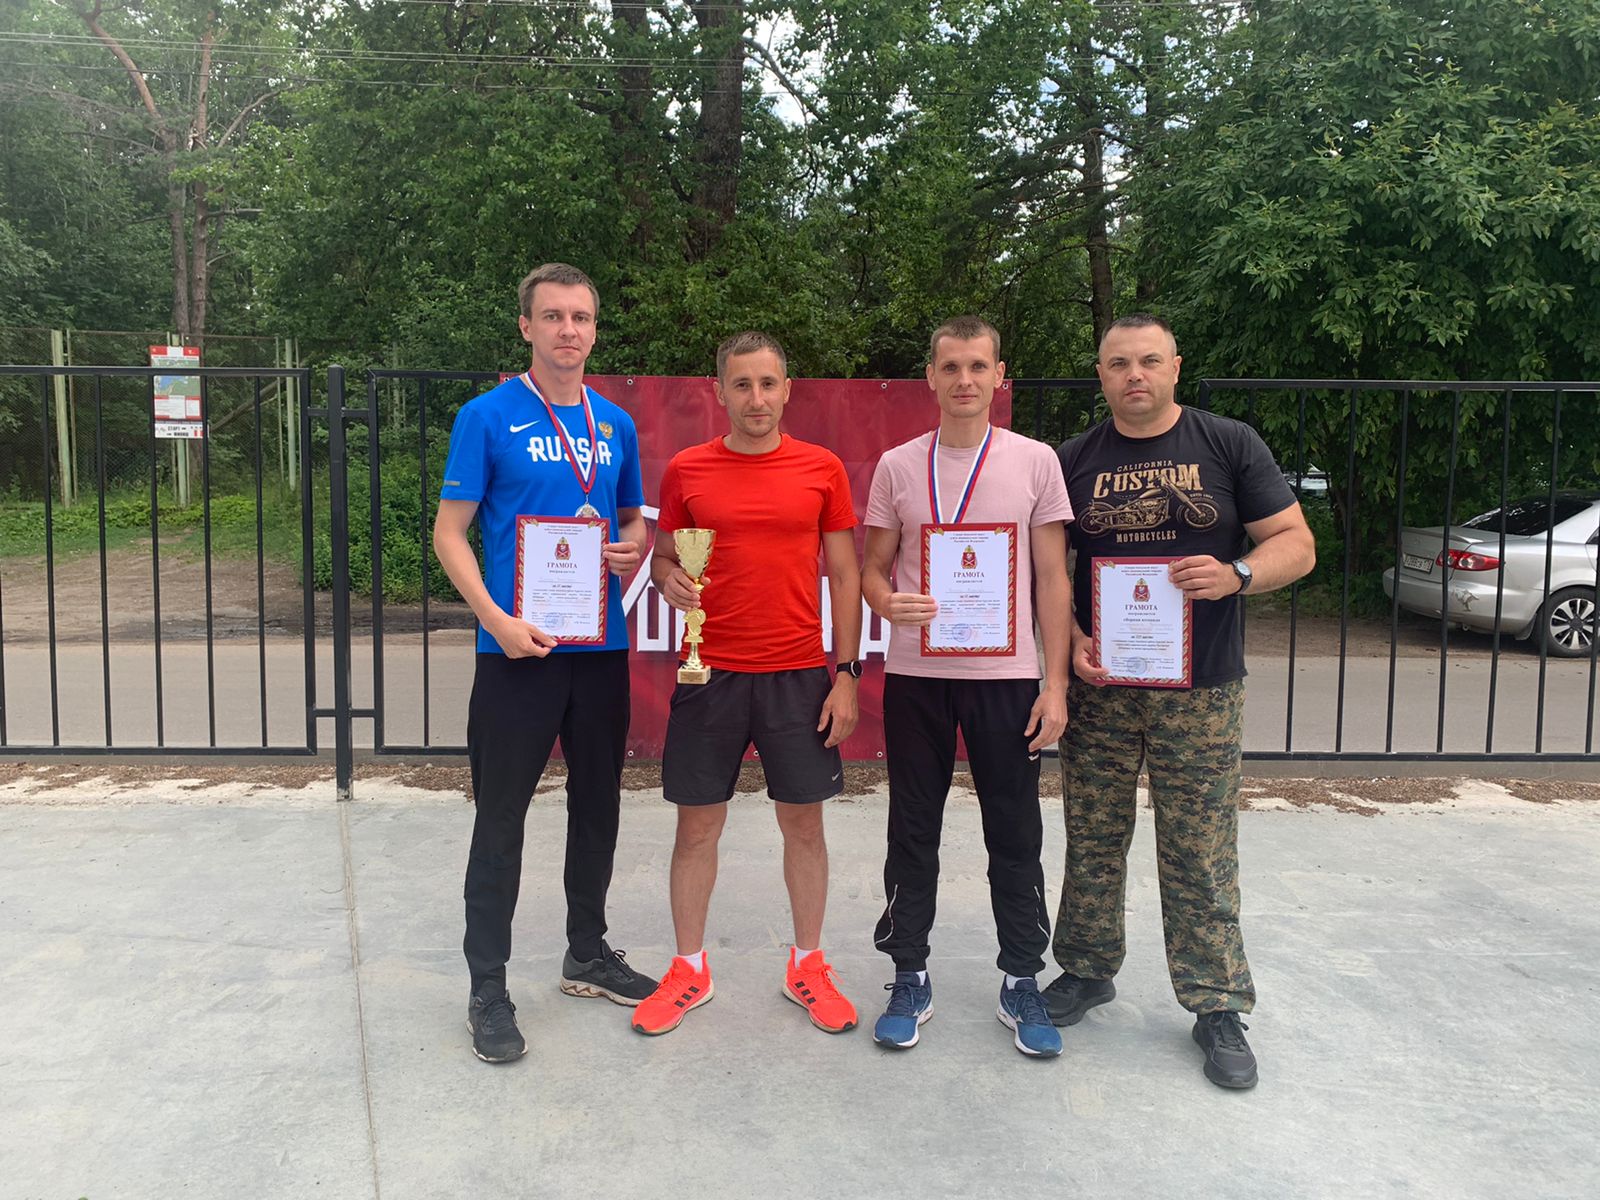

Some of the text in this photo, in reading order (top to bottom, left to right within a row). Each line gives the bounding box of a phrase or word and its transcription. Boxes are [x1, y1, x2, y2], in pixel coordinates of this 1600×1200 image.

[1117, 460, 1173, 472] CALIFORNIA
[1093, 463, 1203, 498] CUSTOM
[1116, 530, 1177, 543] MOTORCYCLES
